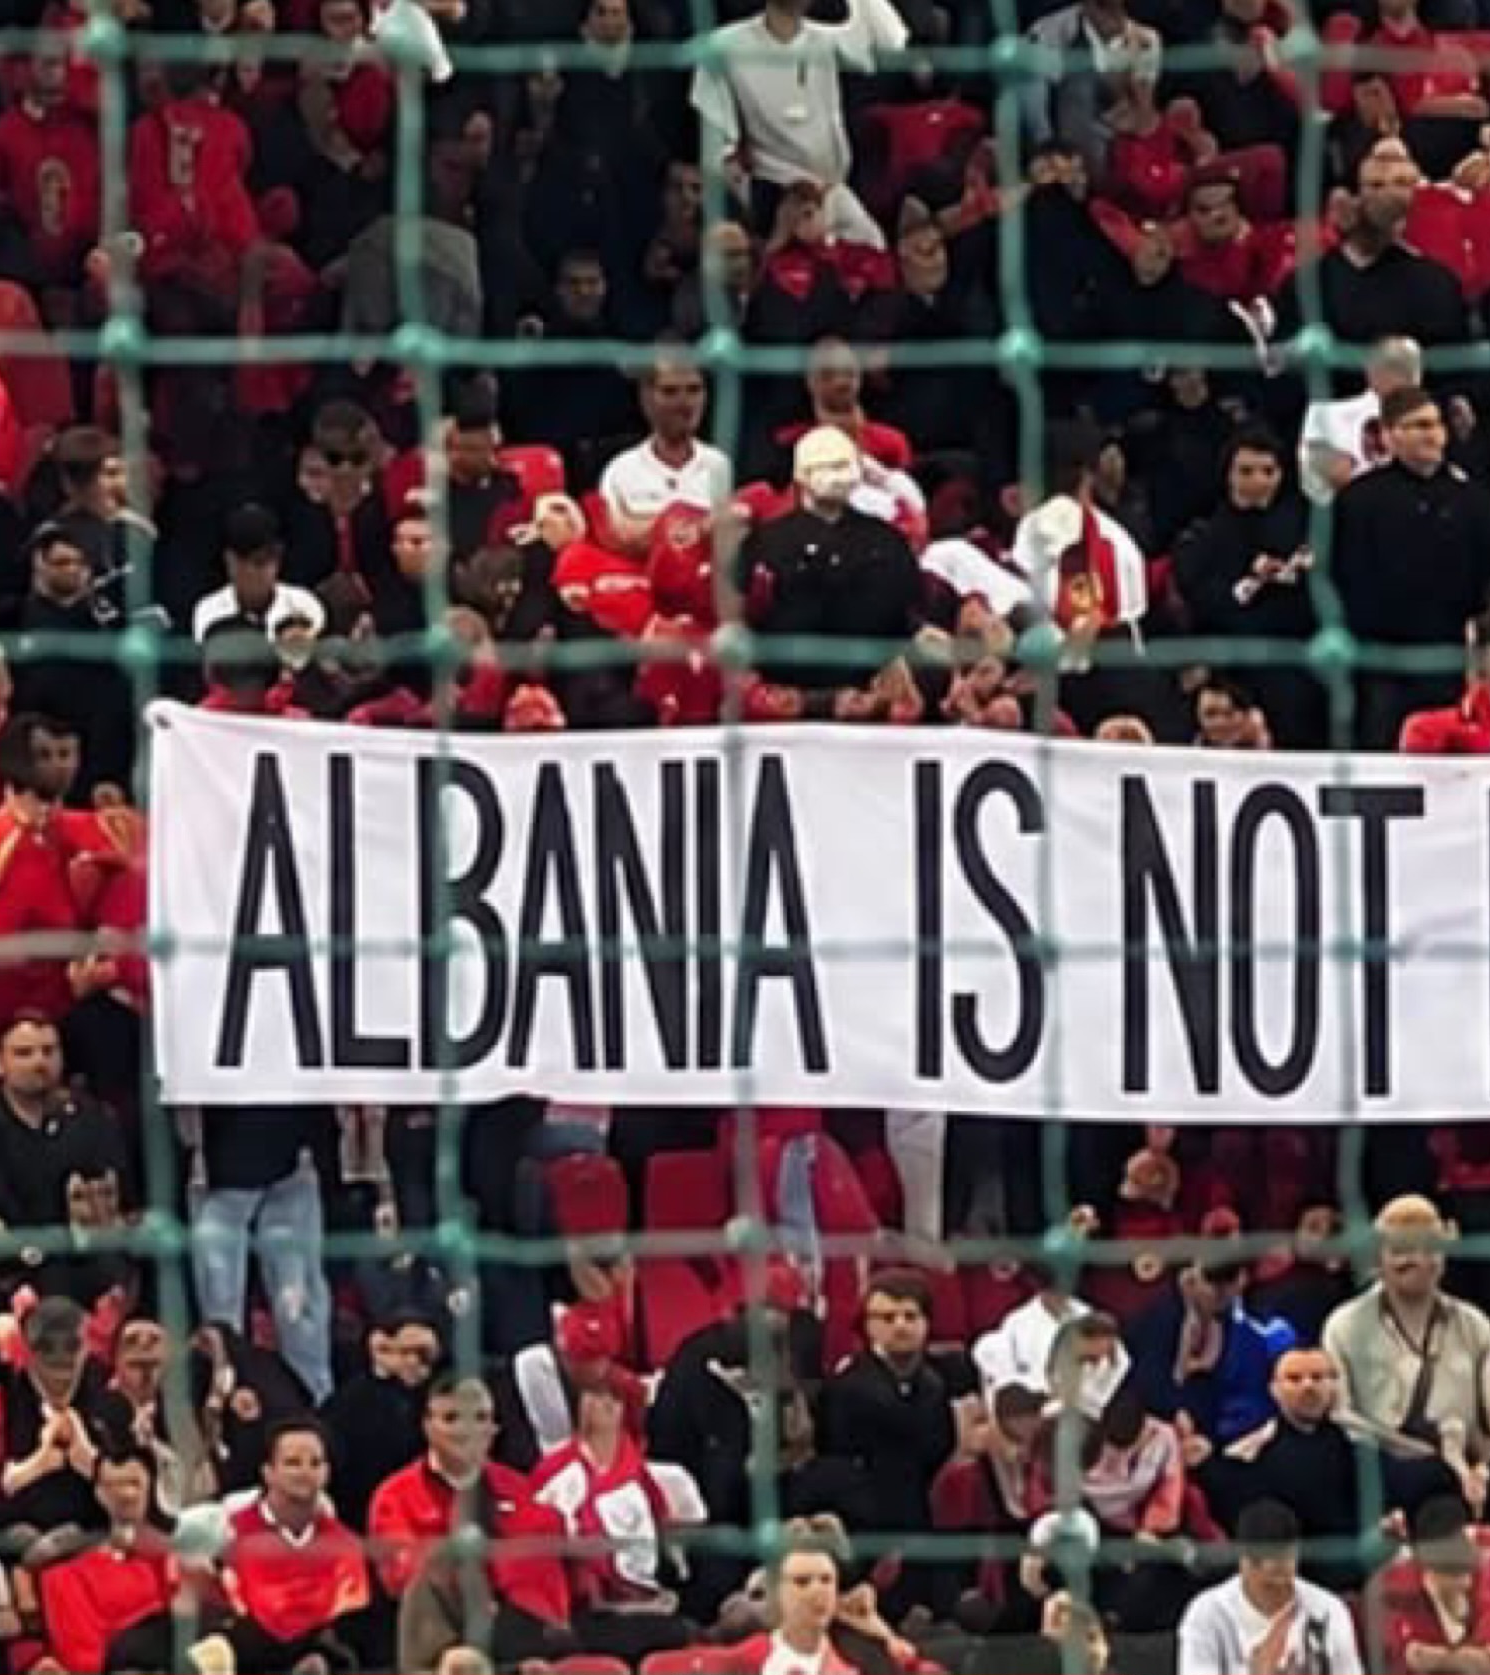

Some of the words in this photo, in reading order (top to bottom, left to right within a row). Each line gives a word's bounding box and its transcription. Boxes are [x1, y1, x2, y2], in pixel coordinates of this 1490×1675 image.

[215, 751, 830, 1074] ALBANIA
[913, 758, 1046, 1085] IS
[1120, 773, 1425, 1099] NOT
